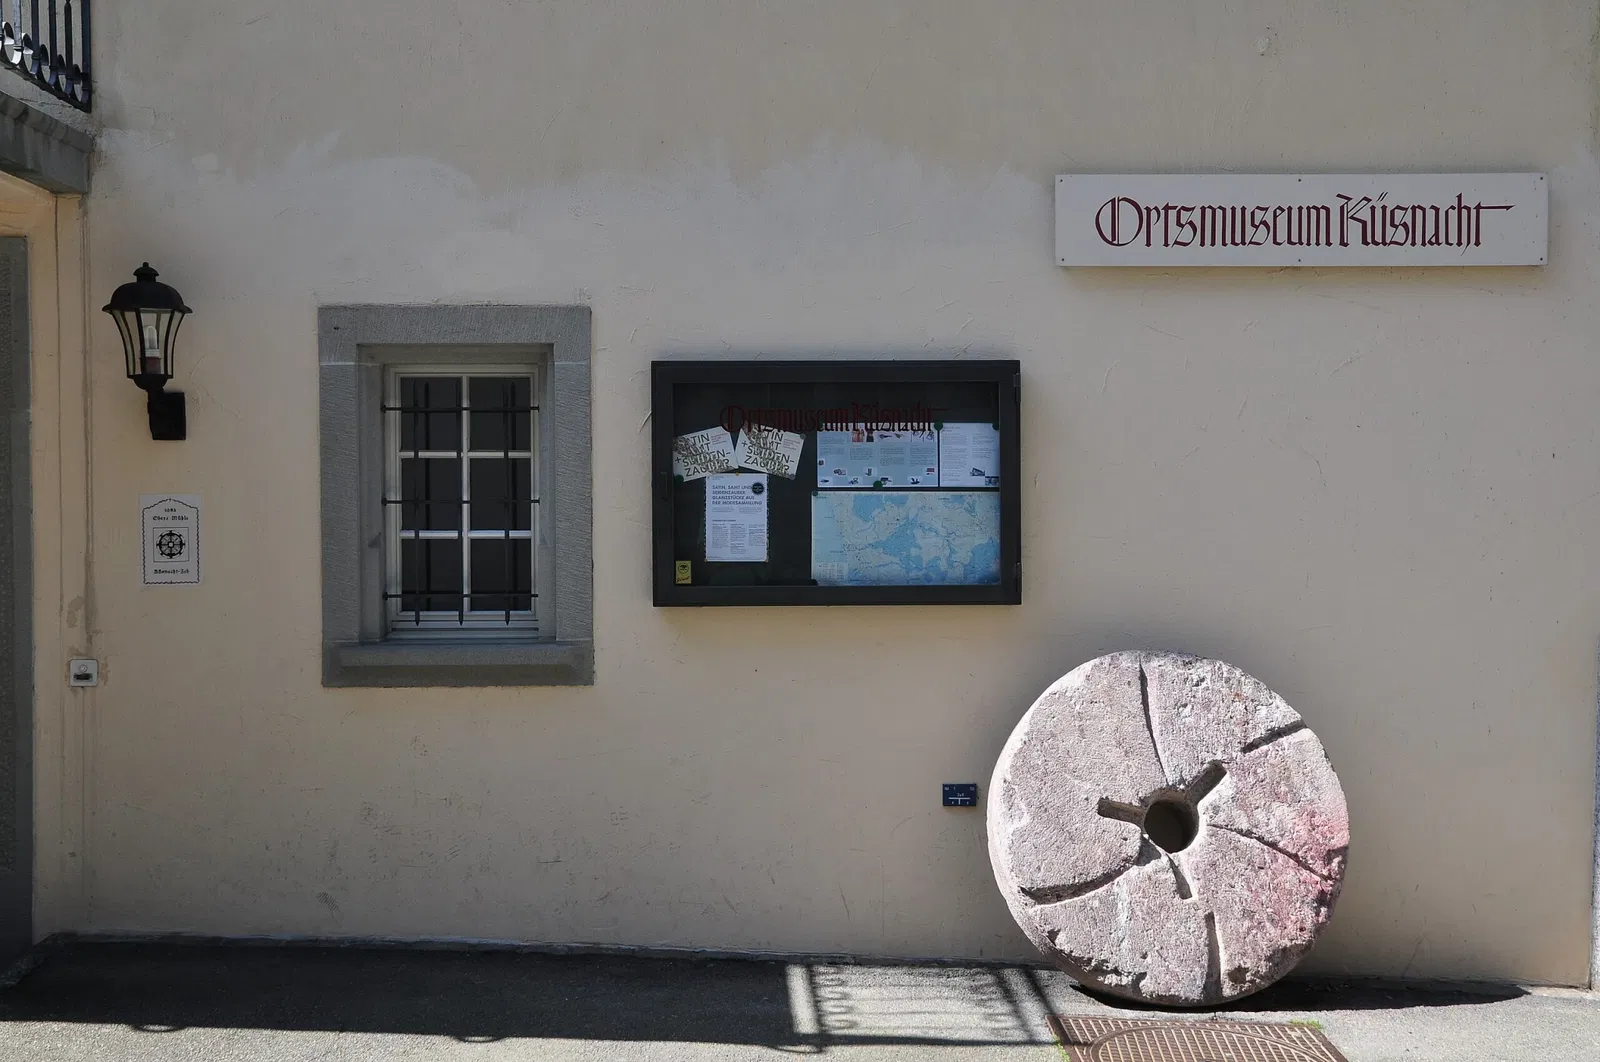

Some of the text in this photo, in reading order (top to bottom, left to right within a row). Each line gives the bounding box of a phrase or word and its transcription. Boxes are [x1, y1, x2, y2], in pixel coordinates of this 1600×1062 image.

[1094, 191, 1514, 256] Ortsmuseum Küsnacht
[719, 404, 849, 433] Ortsmuseum
